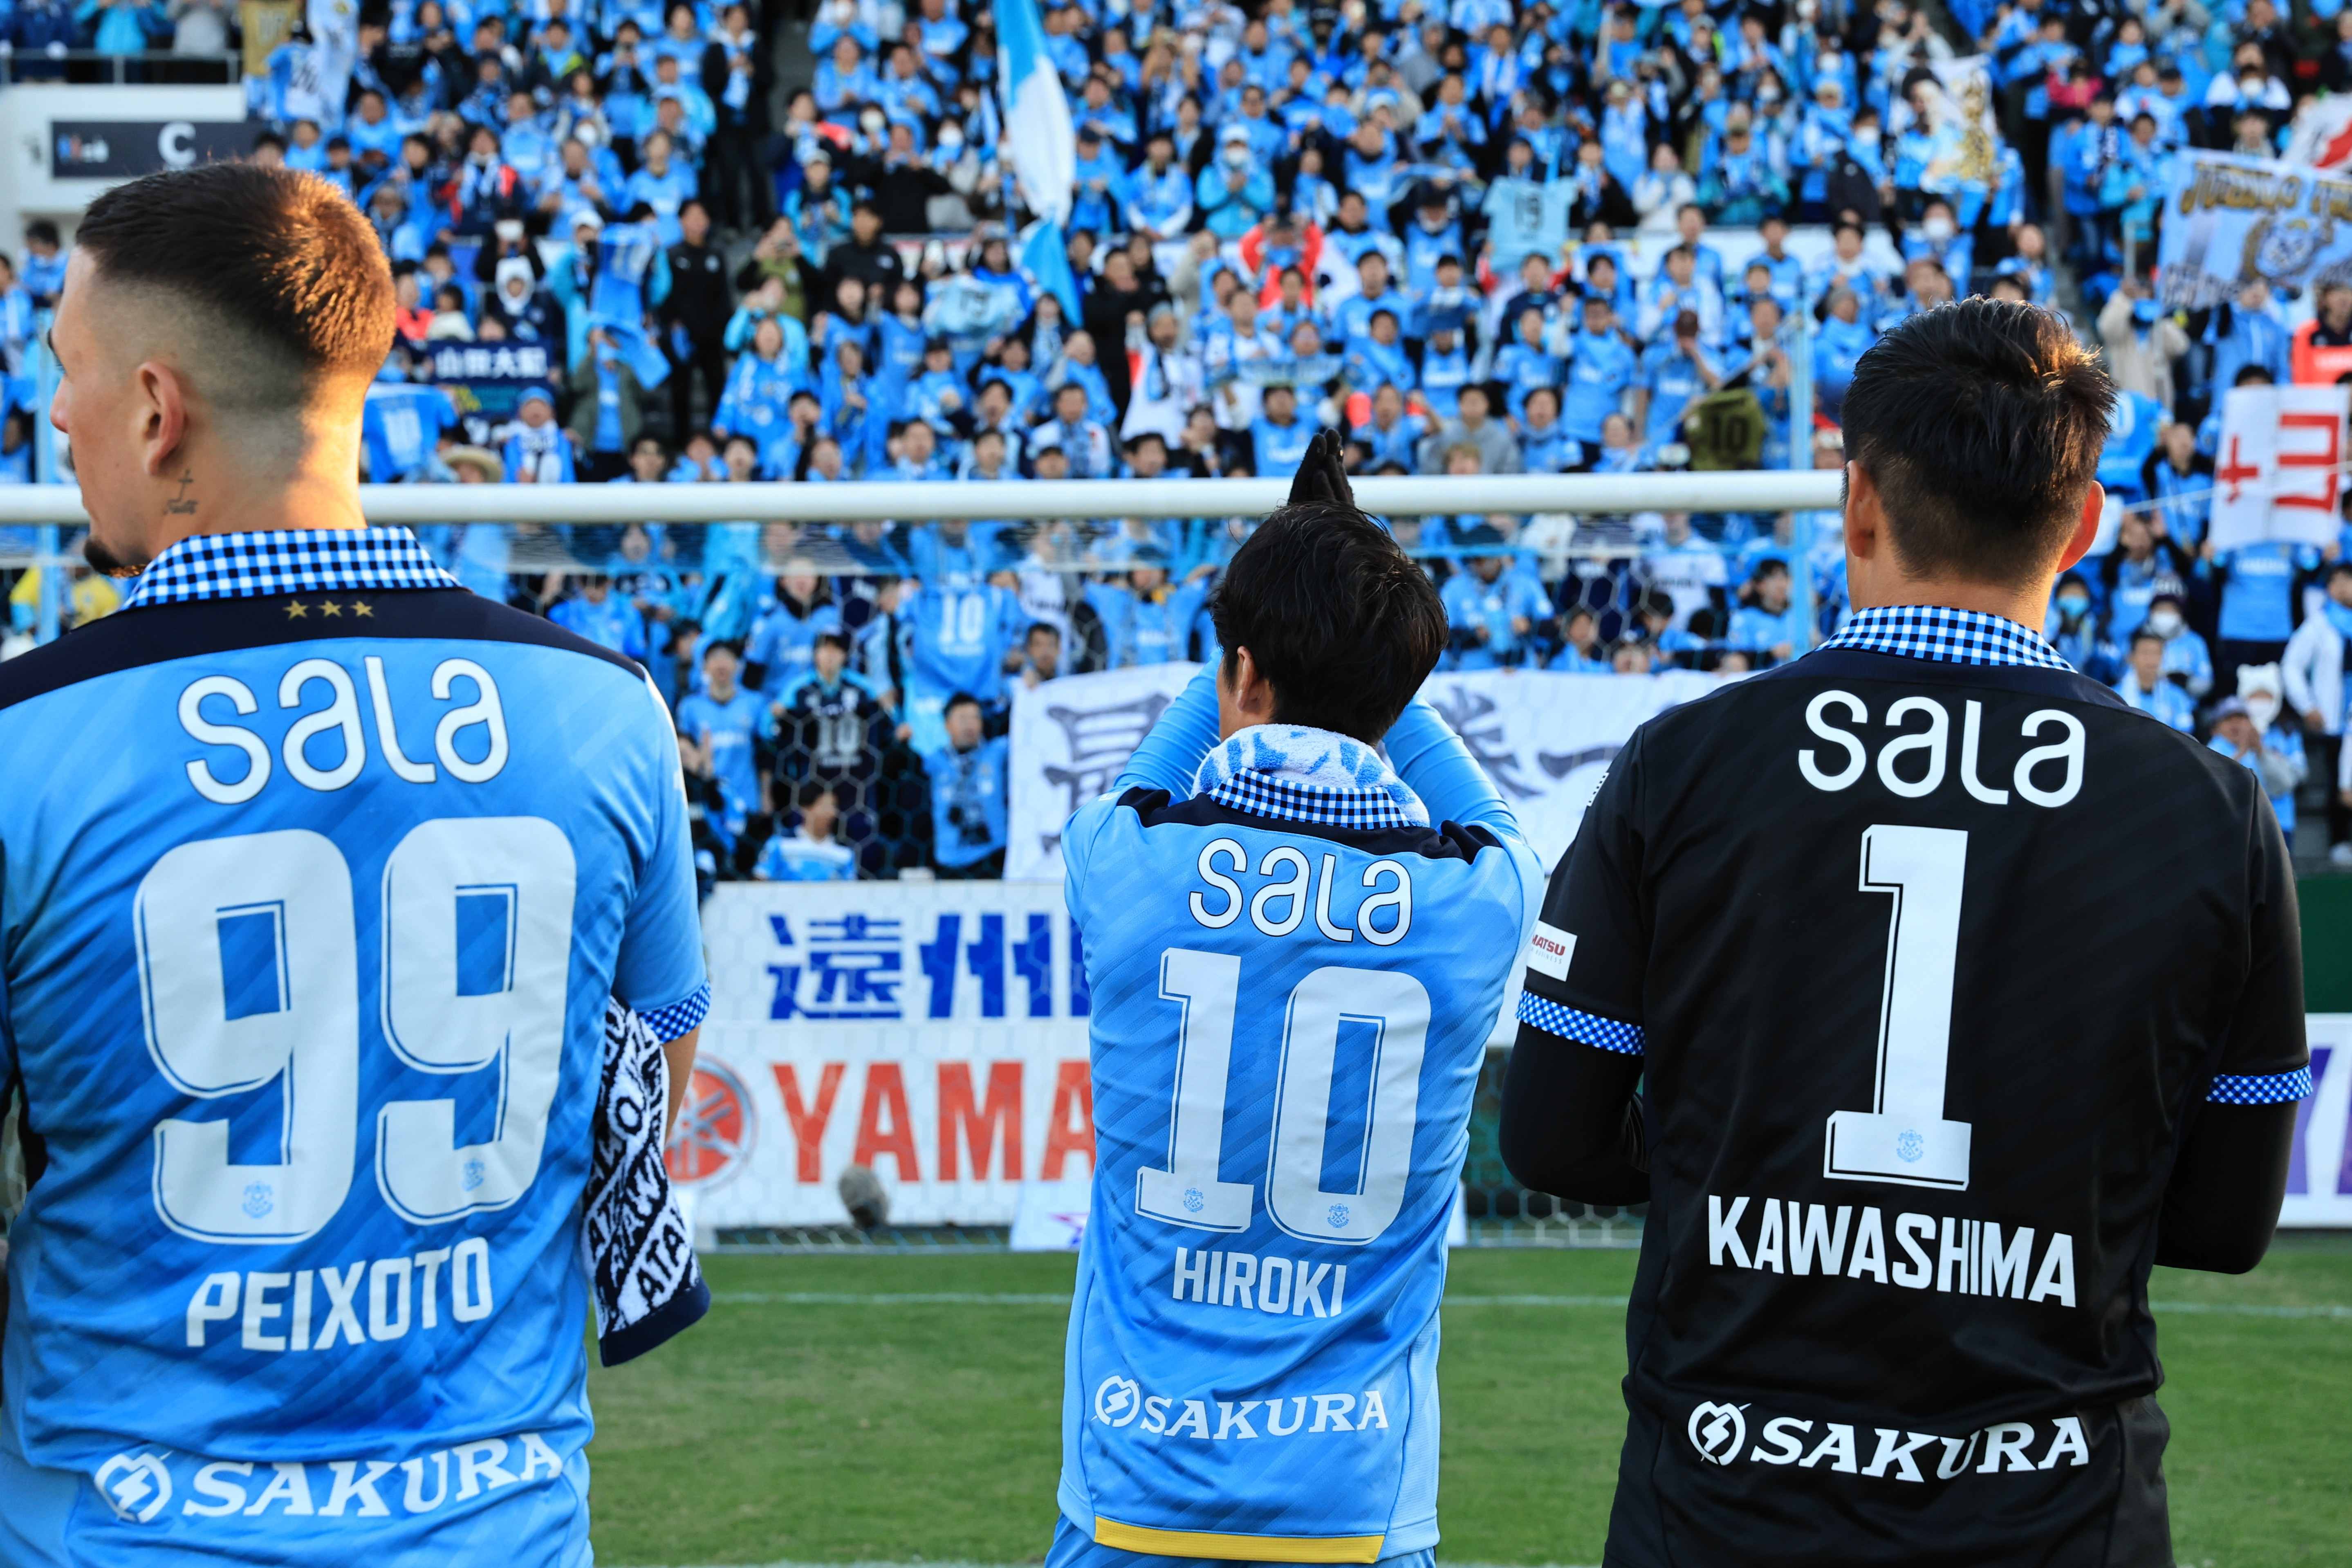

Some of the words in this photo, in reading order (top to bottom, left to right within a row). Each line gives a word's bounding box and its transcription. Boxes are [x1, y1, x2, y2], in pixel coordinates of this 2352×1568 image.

[158, 122, 197, 166] C
[938, 593, 985, 644] 10
[177, 656, 509, 804] sala
[817, 716, 860, 754] 10
[1798, 690, 2086, 808] sala
[1188, 838, 1412, 947] sala
[132, 816, 577, 1245] 99
[1823, 823, 1971, 1191] 1
[770, 1059, 1096, 1184] YAMA
[1135, 947, 1431, 1246] 10
[186, 1237, 492, 1351] PEIXOTO
[1172, 1246, 1347, 1318] HIROKI
[1709, 1194, 2076, 1308] KAWASHIMA
[1140, 1390, 1389, 1440] SAKURA
[1750, 1416, 2089, 1483] SAKURA
[182, 1433, 563, 1517] SAKURA
